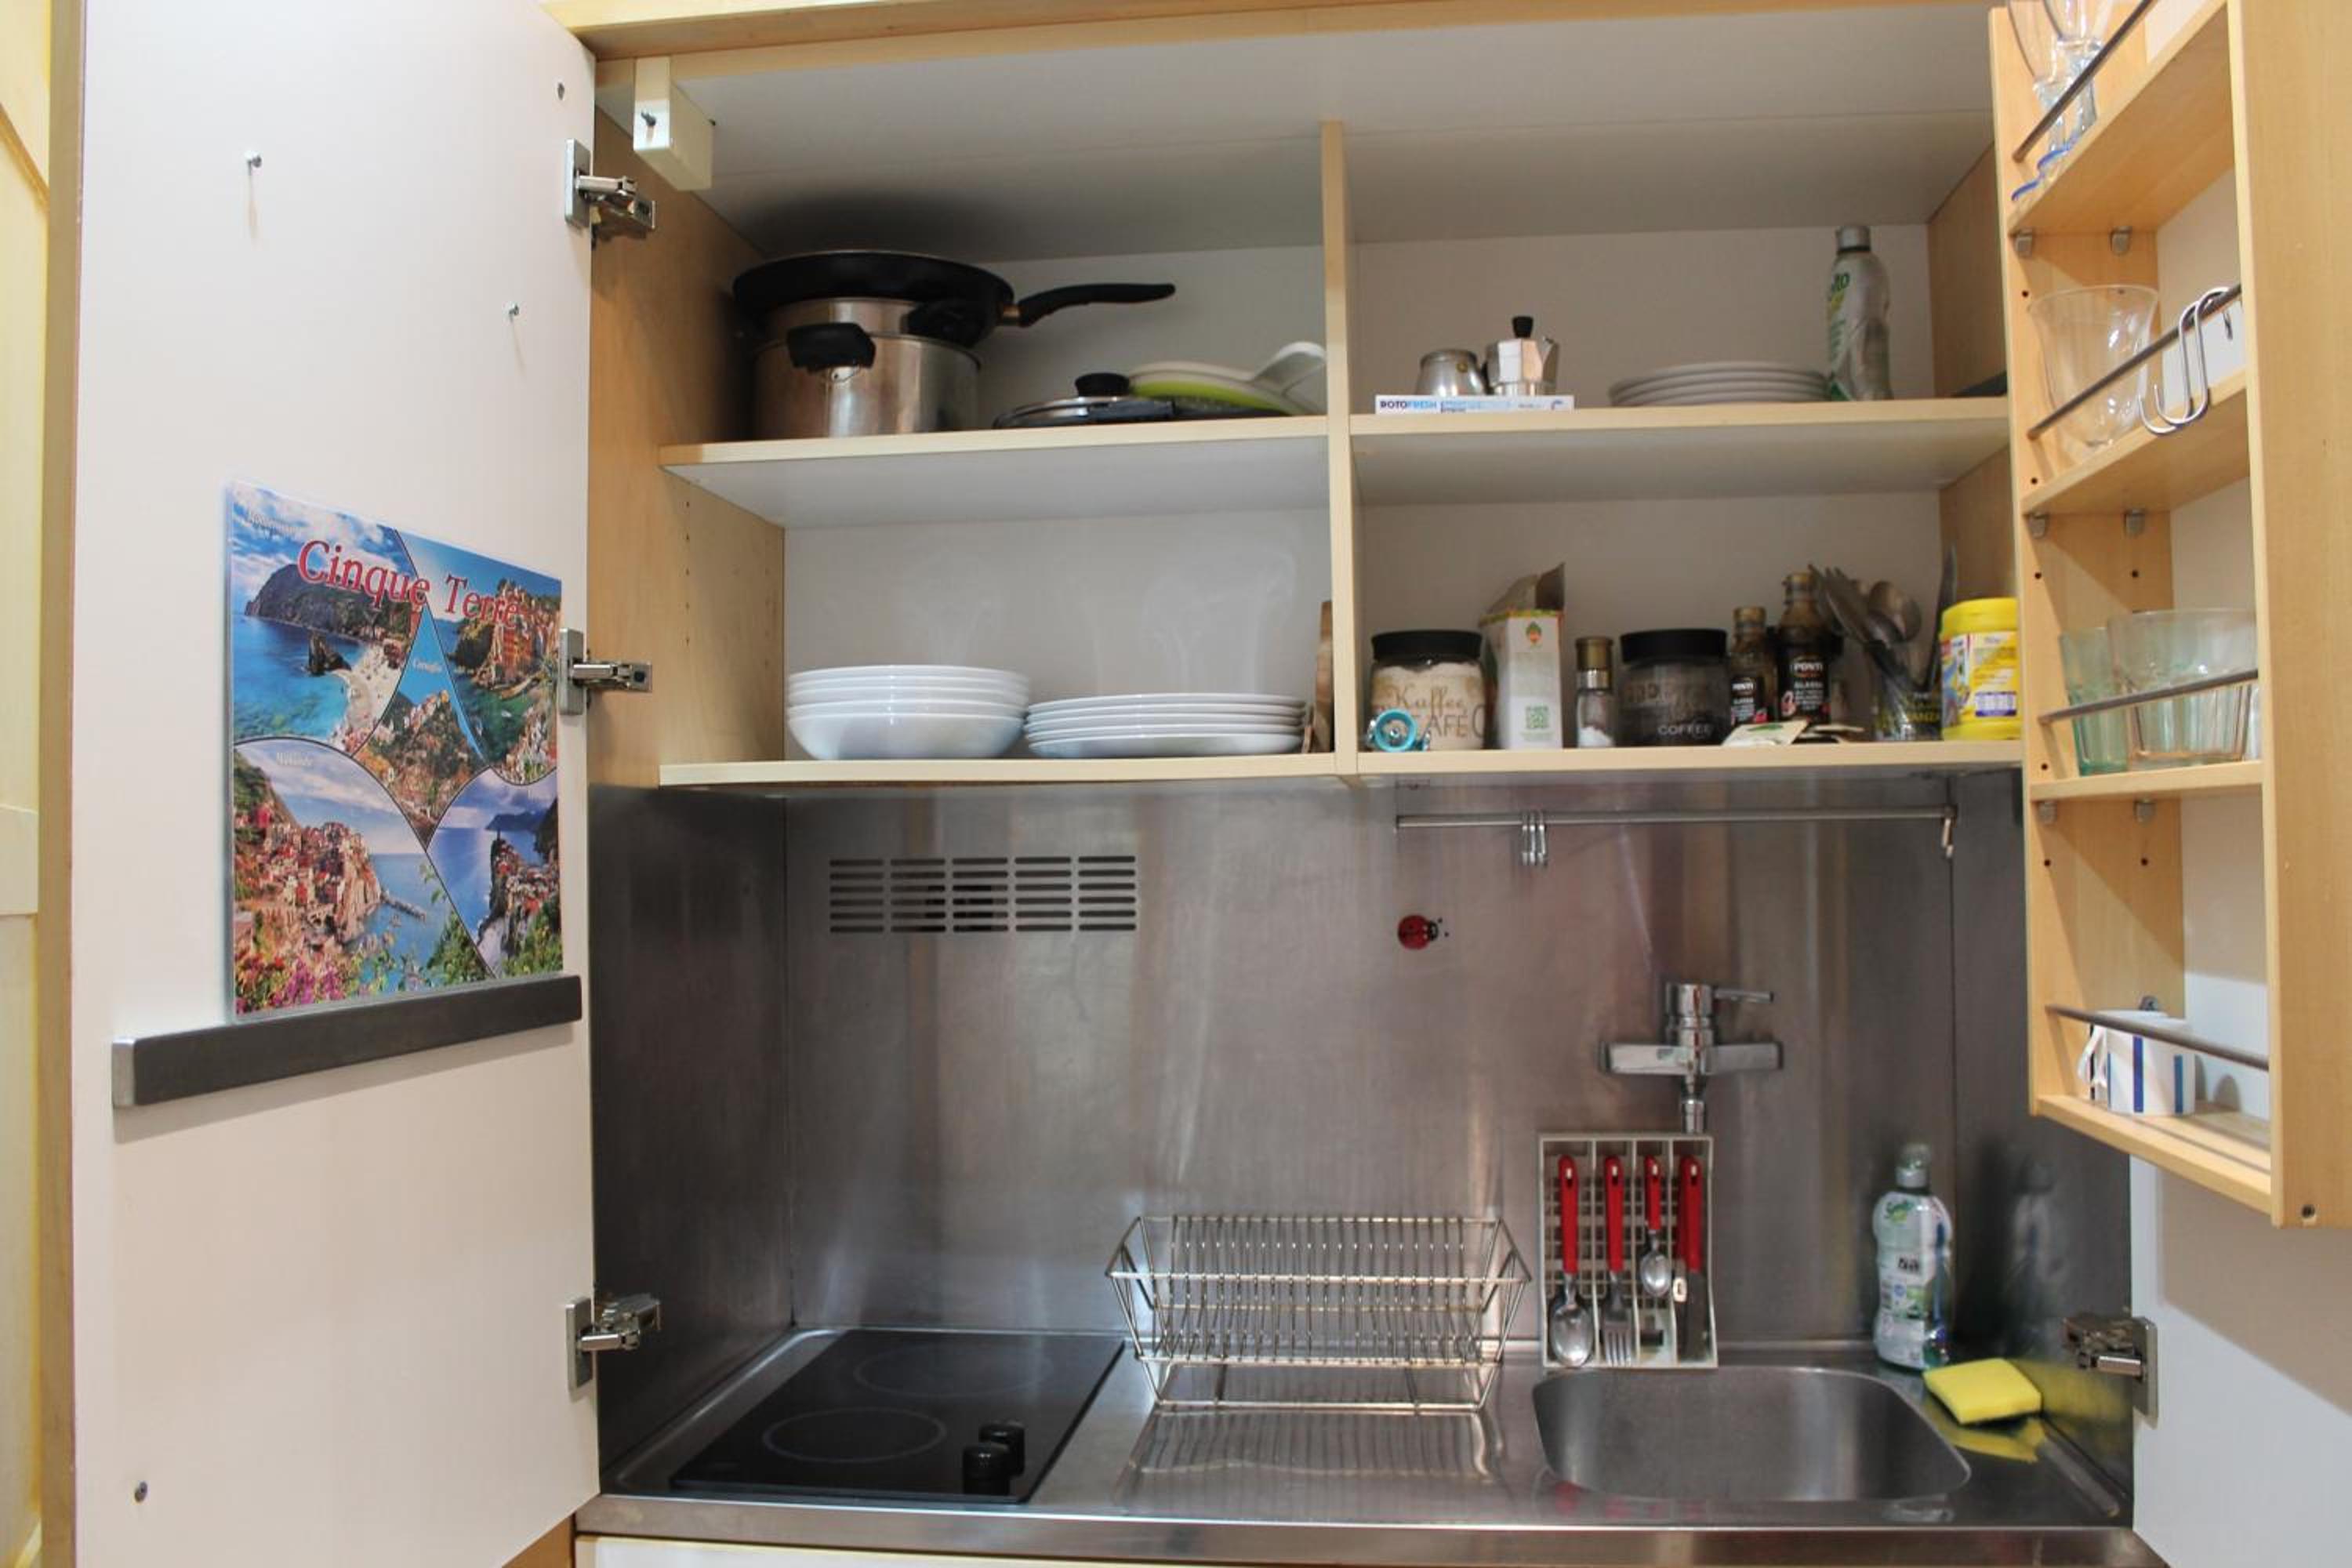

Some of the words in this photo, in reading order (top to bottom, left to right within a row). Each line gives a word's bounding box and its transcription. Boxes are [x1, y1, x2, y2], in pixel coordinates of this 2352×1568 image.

[296, 539, 430, 612] Cinque
[445, 573, 521, 627] Terre
[1792, 662, 1824, 673] PONTI
[1657, 724, 1713, 736] COFFEE
